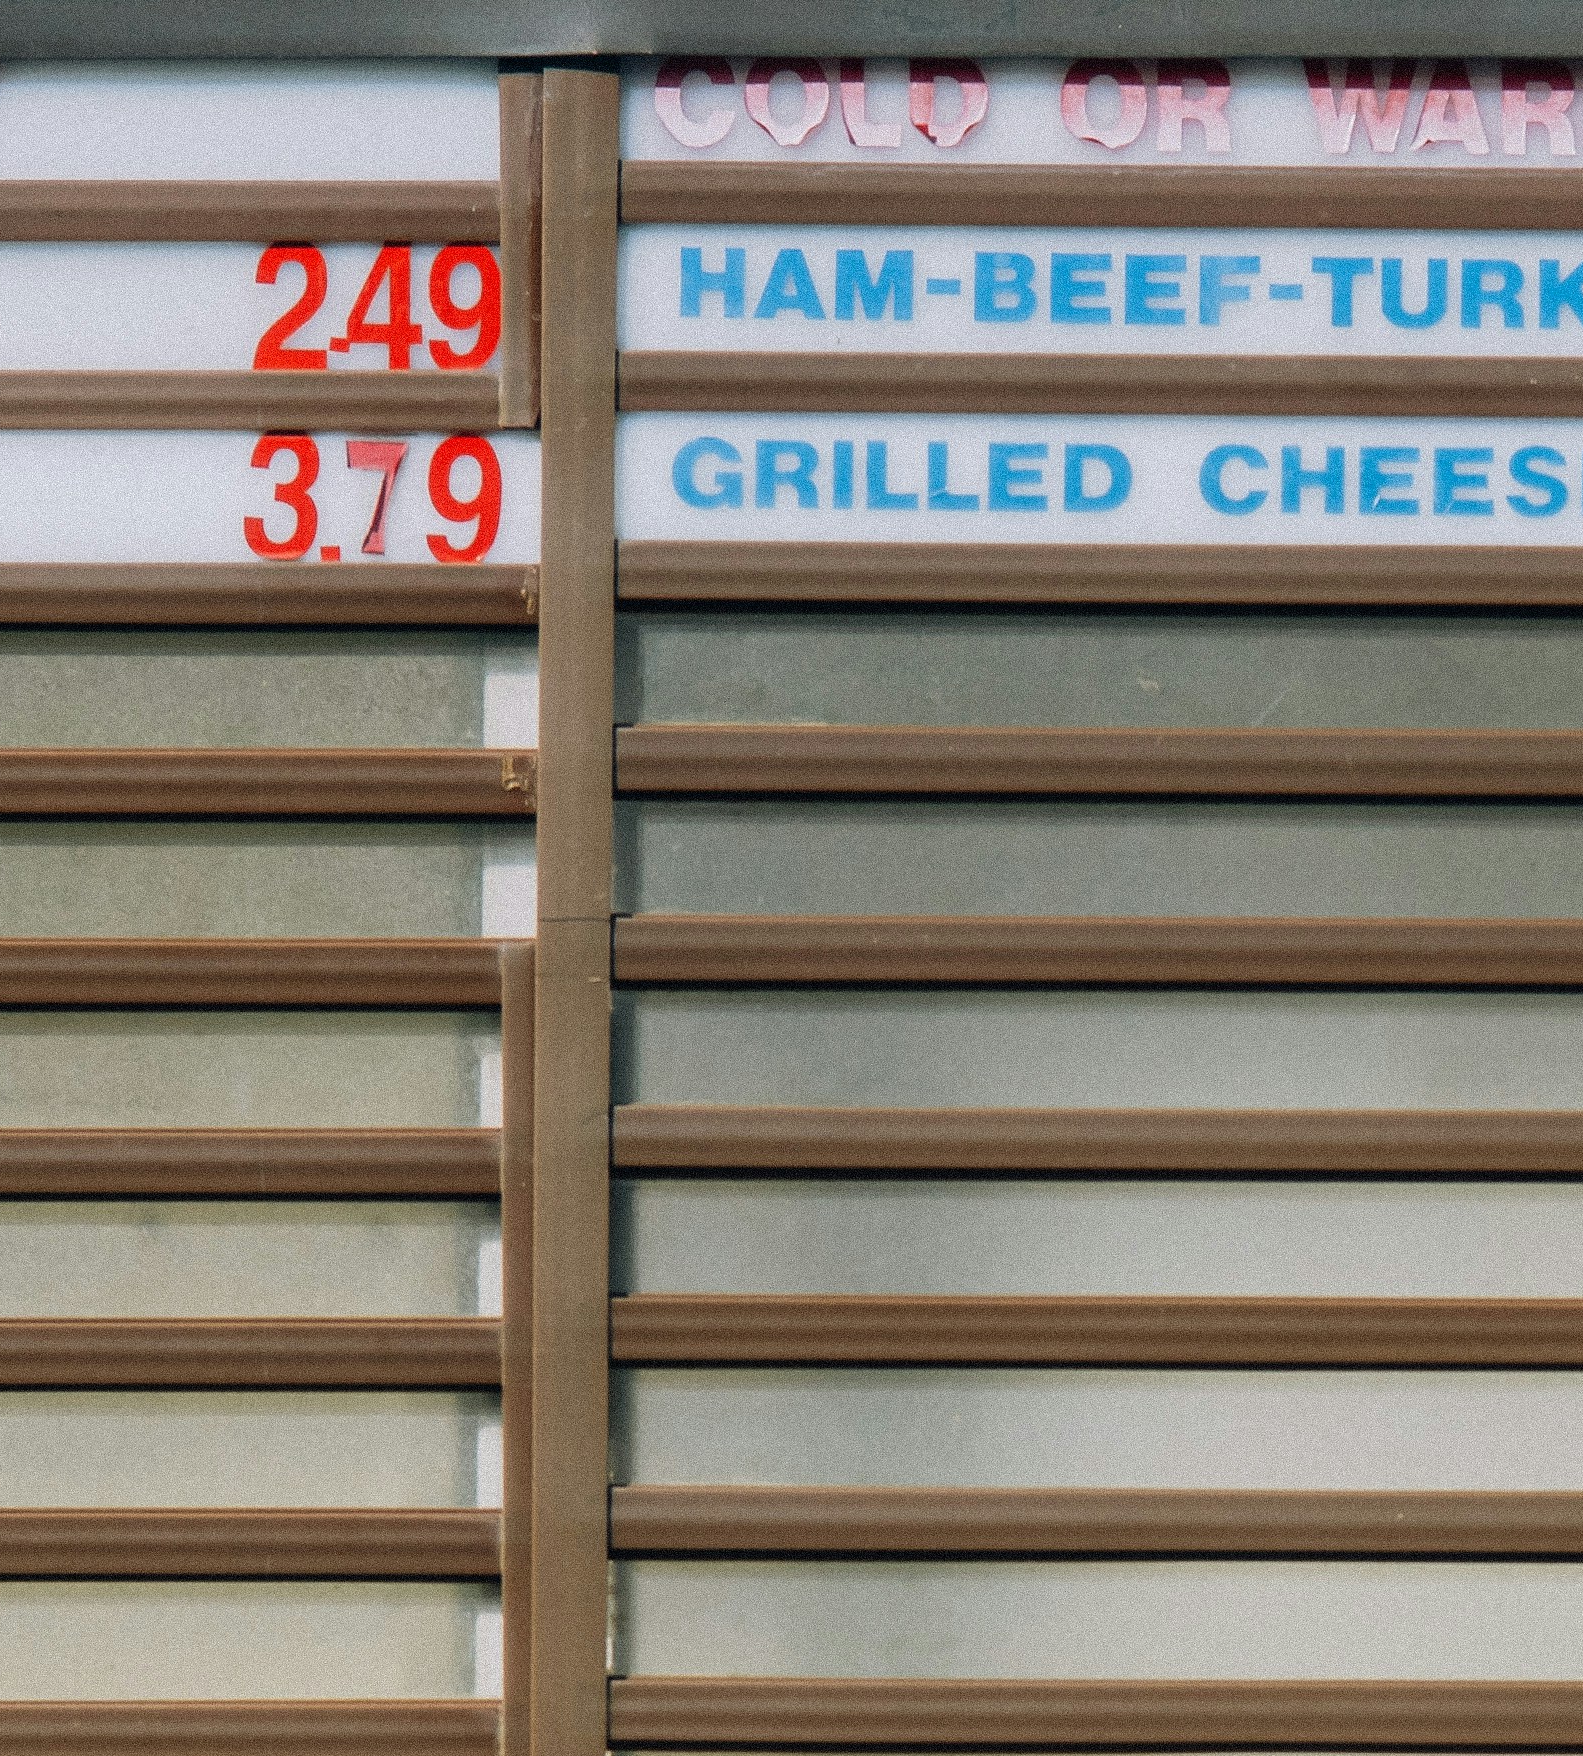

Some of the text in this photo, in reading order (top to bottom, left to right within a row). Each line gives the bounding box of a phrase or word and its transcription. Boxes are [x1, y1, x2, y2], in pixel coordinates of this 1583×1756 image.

[655, 58, 989, 149] COLD
[1060, 59, 1232, 151] OR
[253, 243, 502, 371] 2.49
[244, 434, 502, 563] 3.79
[671, 435, 1134, 514] GRILLED
